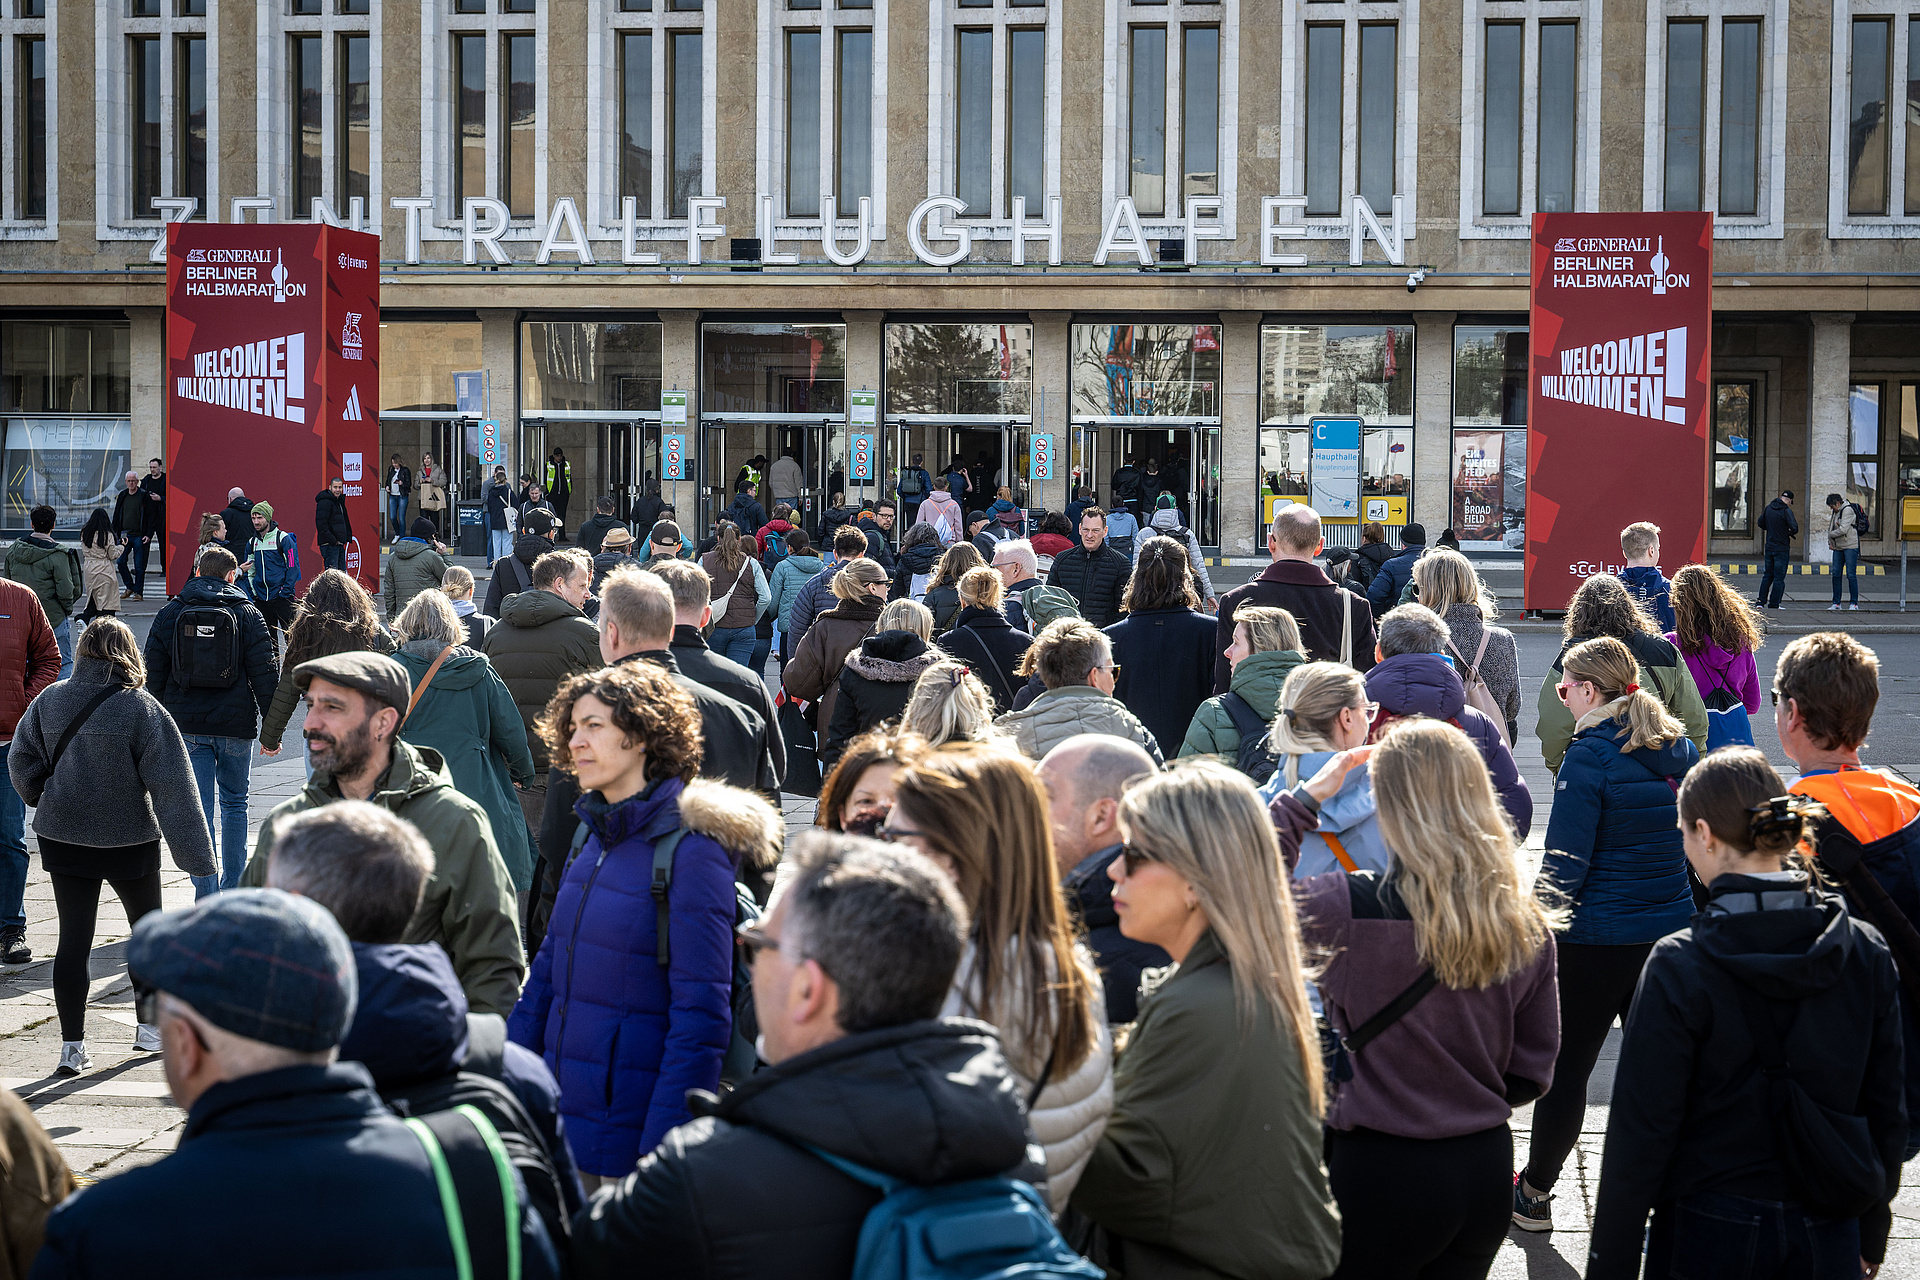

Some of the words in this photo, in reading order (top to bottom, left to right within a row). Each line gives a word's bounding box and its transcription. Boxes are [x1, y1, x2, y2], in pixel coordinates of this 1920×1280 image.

[1577, 237, 1651, 252] GENERALI
[207, 249, 271, 263] GENERALI
[349, 258, 368, 270] EVENTS
[1553, 256, 1634, 271] BERLINER
[186, 266, 257, 280] BERLINER
[1553, 274, 1690, 288] HALBMARATHON
[186, 283, 307, 297] HALBMARATHON
[193, 336, 286, 378] WELCOME
[1561, 330, 1665, 376] WELCOME
[1316, 424, 1327, 440] C
[1315, 453, 1358, 462] Haupthalle
[1465, 449, 1480, 458] EIN
[1315, 464, 1357, 473] Haupteingang
[1465, 459, 1497, 468] WEITES
[1465, 468, 1486, 477] FELD
[1464, 496, 1471, 505] A
[1464, 505, 1491, 514] BROAD
[1464, 515, 1485, 524] FIELD
